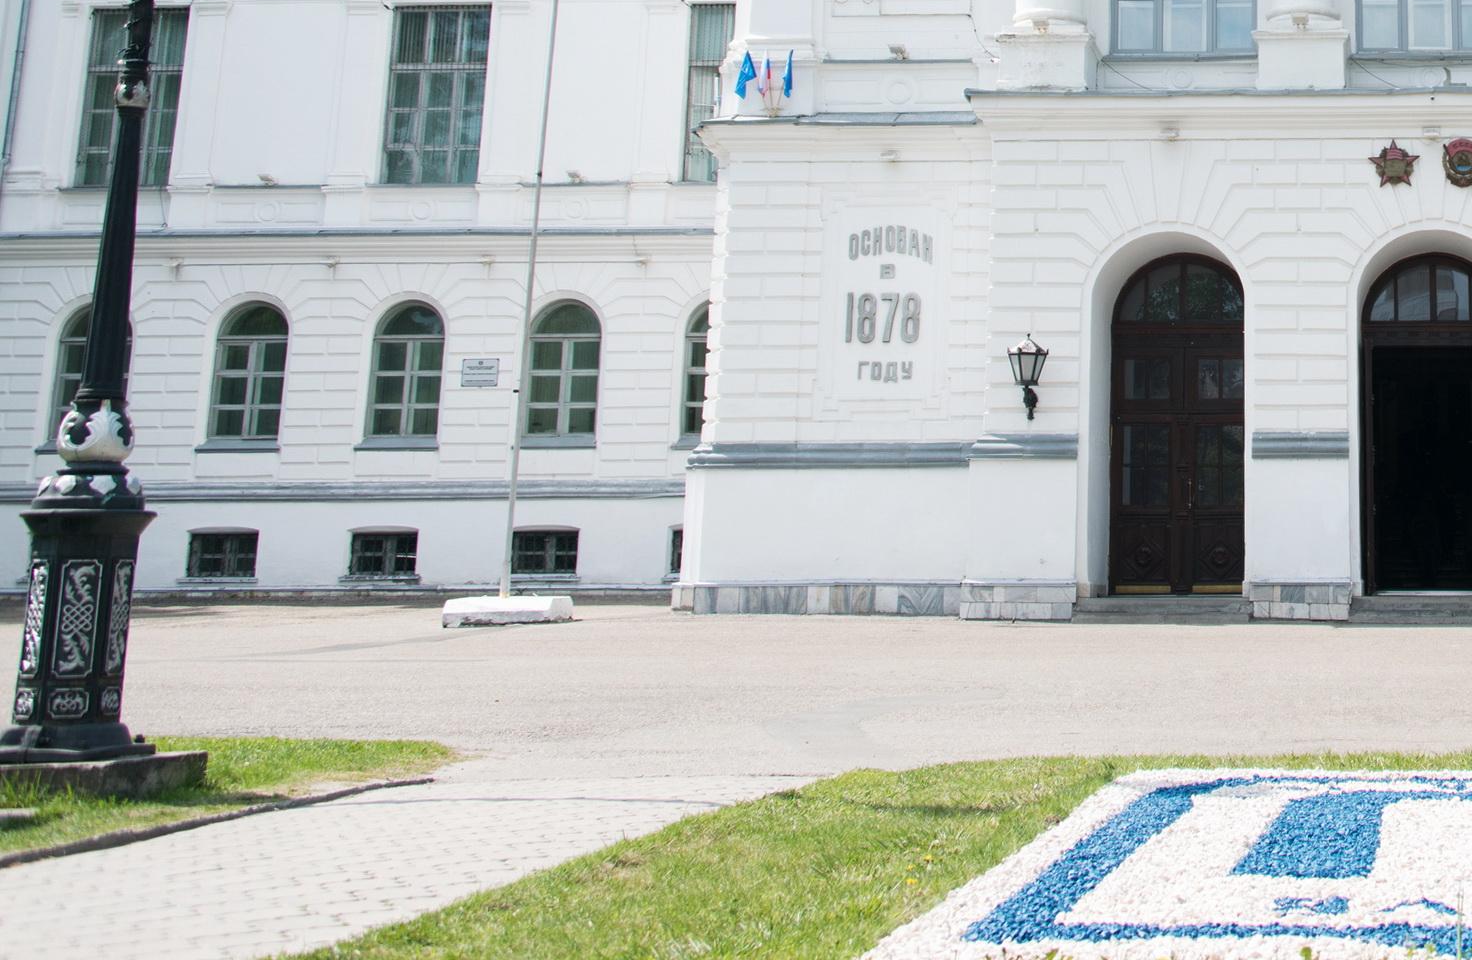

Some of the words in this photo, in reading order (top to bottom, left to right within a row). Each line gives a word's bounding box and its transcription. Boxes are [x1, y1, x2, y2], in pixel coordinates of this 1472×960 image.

[848, 224, 934, 265] ОСНОВАН
[879, 263, 896, 280] В
[844, 291, 922, 345] 1878
[857, 360, 914, 384] ГОДУ
